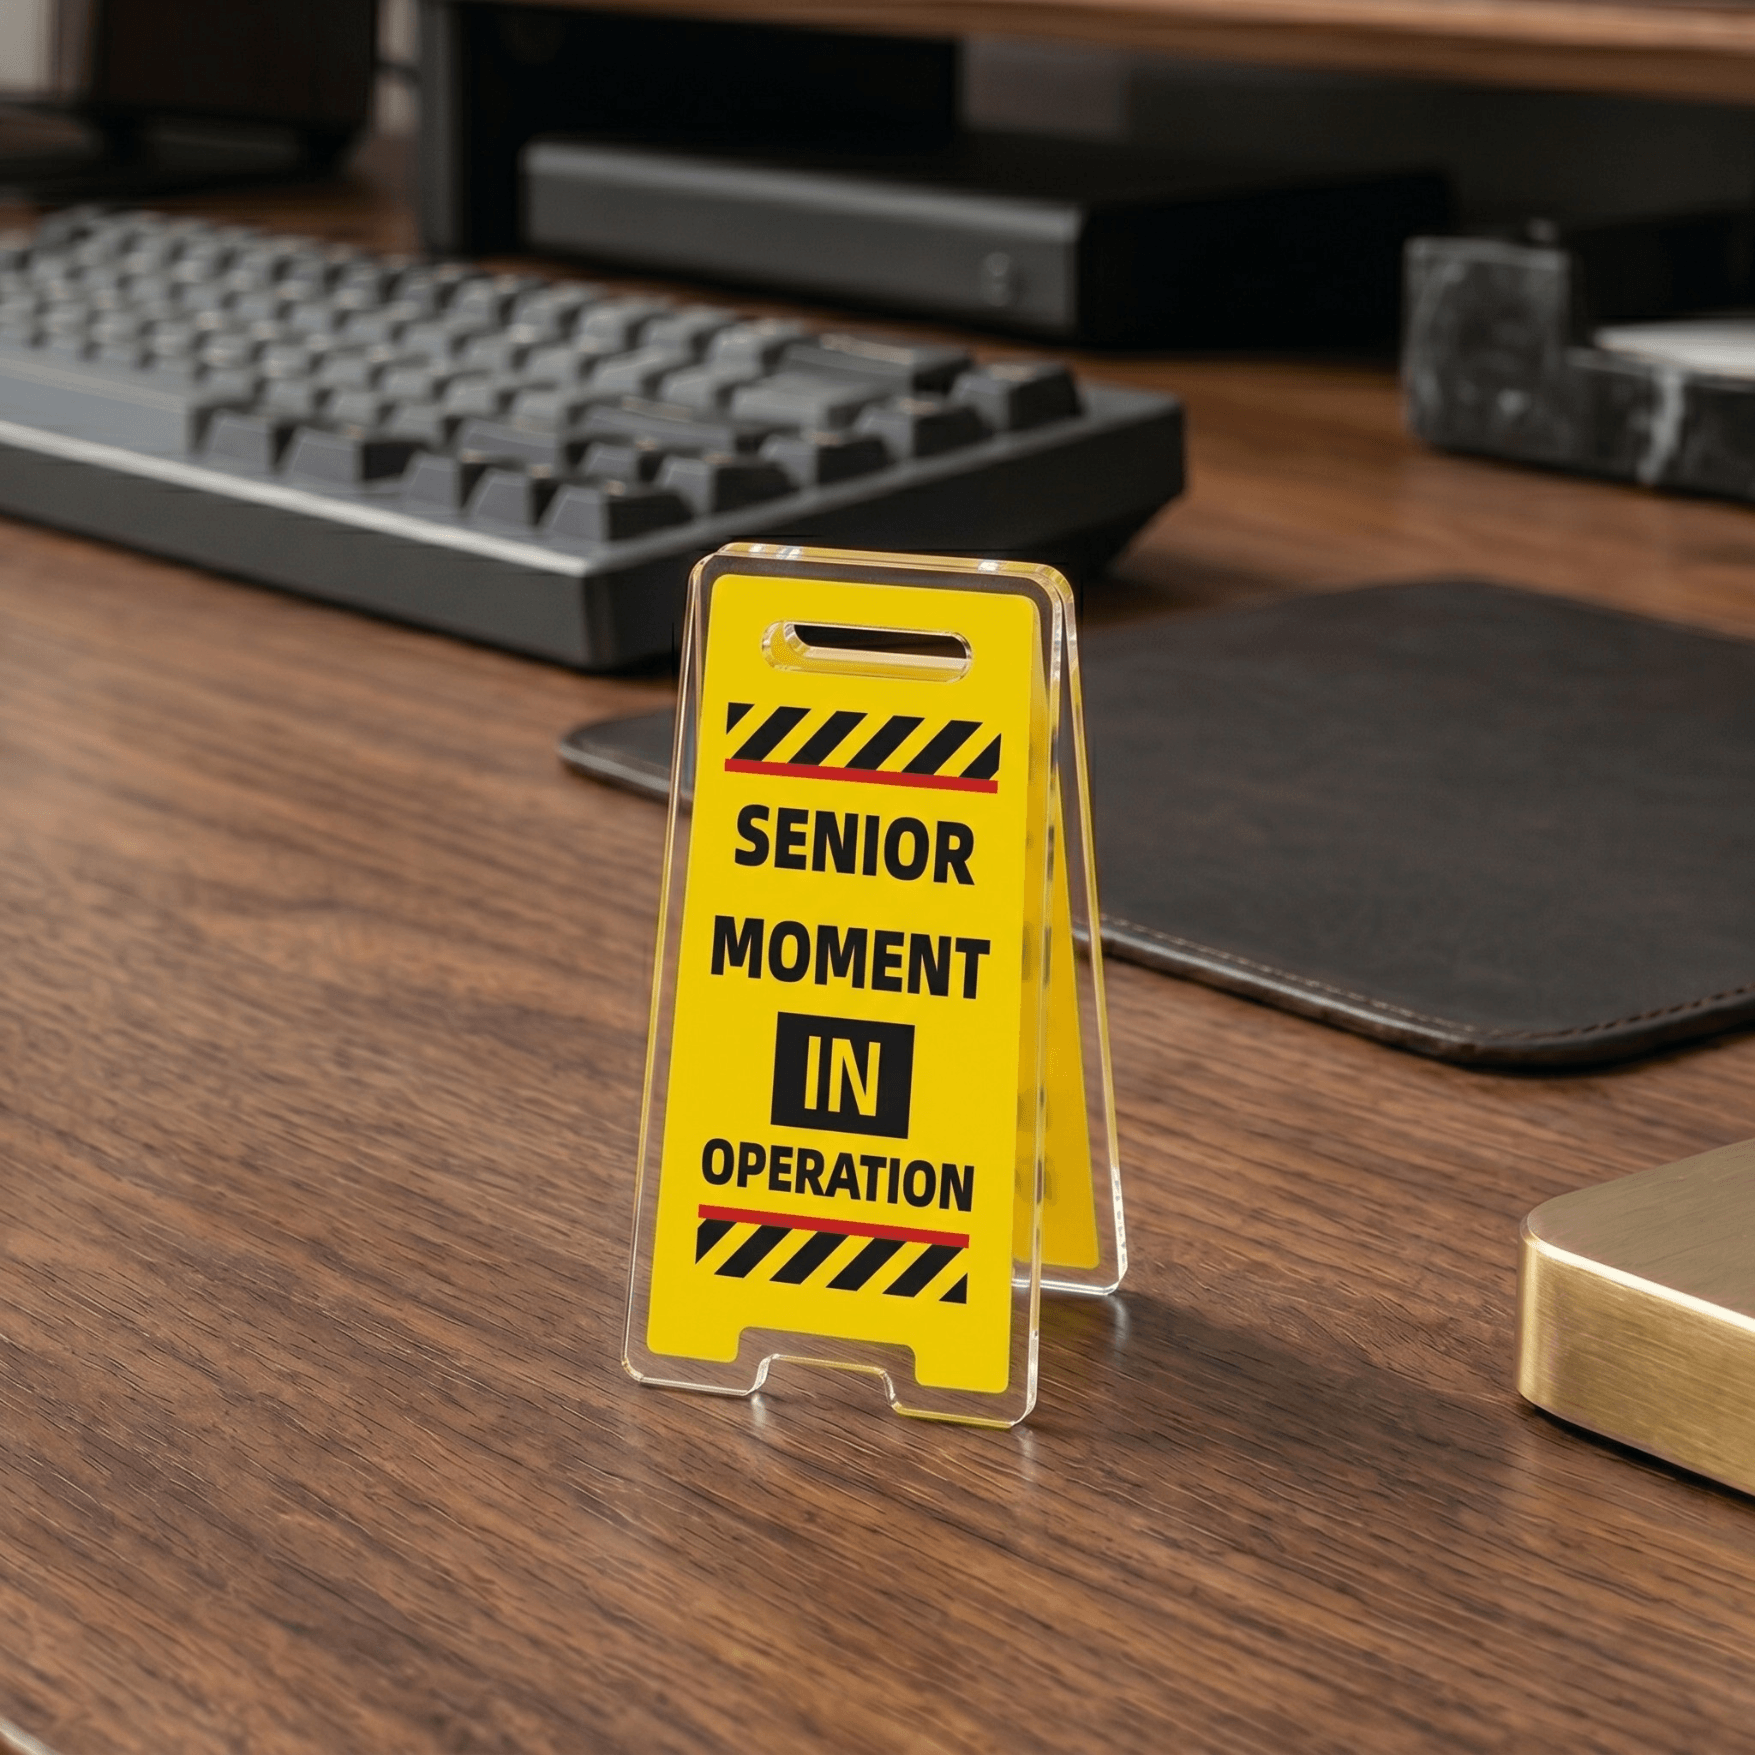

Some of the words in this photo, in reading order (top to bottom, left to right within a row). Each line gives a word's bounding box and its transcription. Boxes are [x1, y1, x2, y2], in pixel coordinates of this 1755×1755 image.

[735, 804, 975, 886] SENIOR
[710, 914, 991, 1000] MOMENT
[804, 1035, 881, 1117] IN
[701, 1138, 975, 1212] OPERATION
